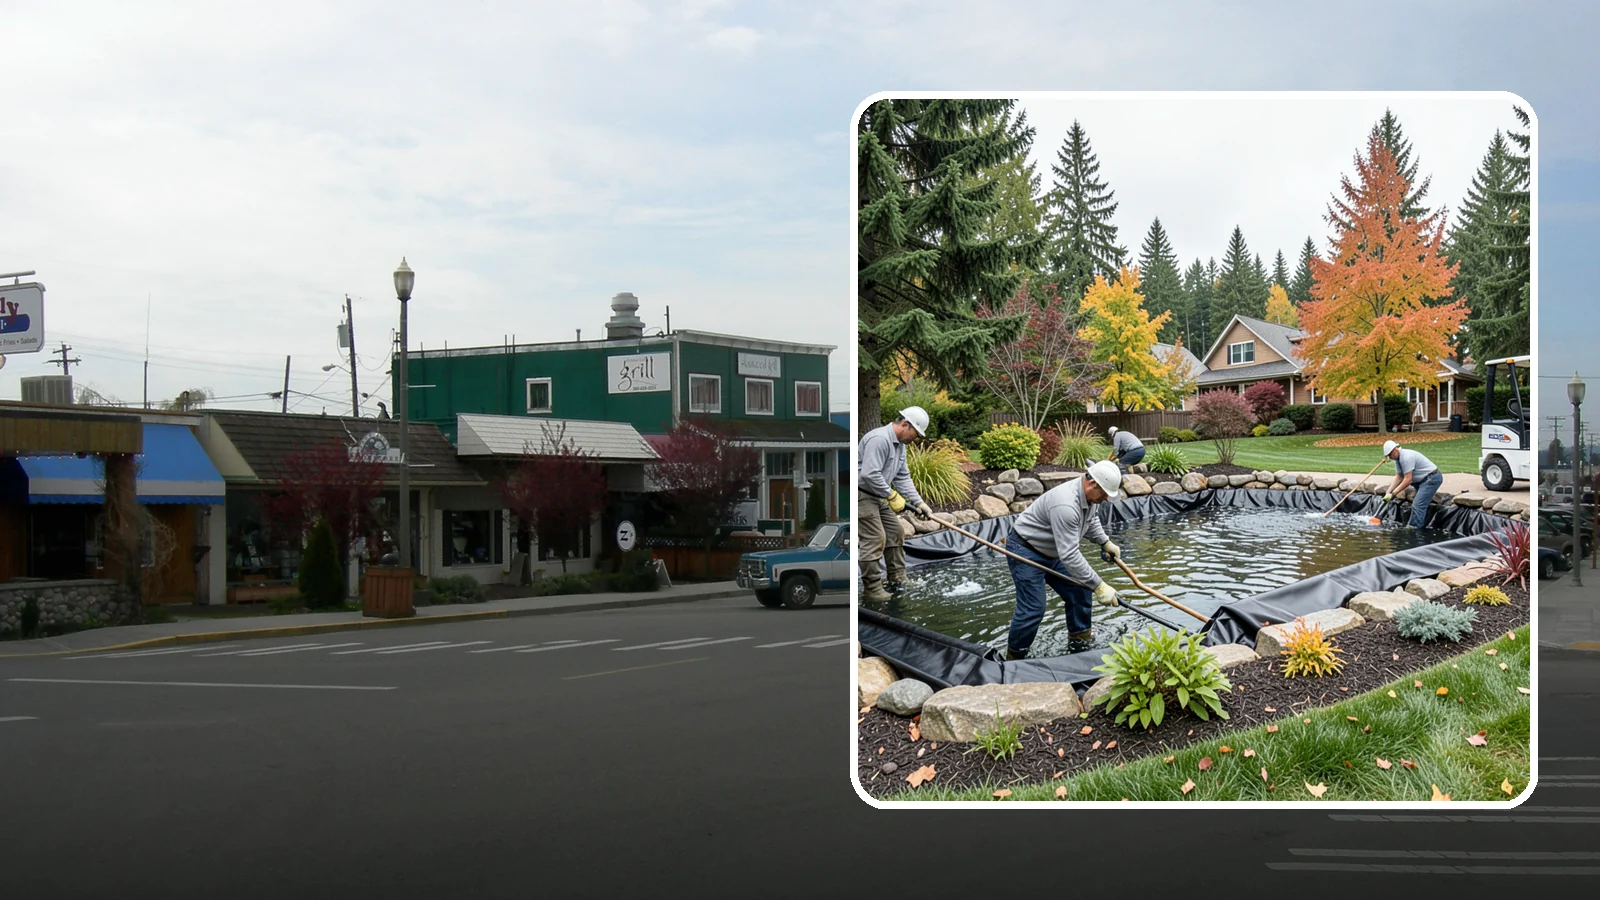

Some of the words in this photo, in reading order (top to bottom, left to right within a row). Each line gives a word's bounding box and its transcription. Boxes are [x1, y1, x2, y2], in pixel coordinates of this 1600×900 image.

[0, 297, 19, 324] ly
[20, 337, 38, 345] Salads
[618, 356, 655, 391] grill
